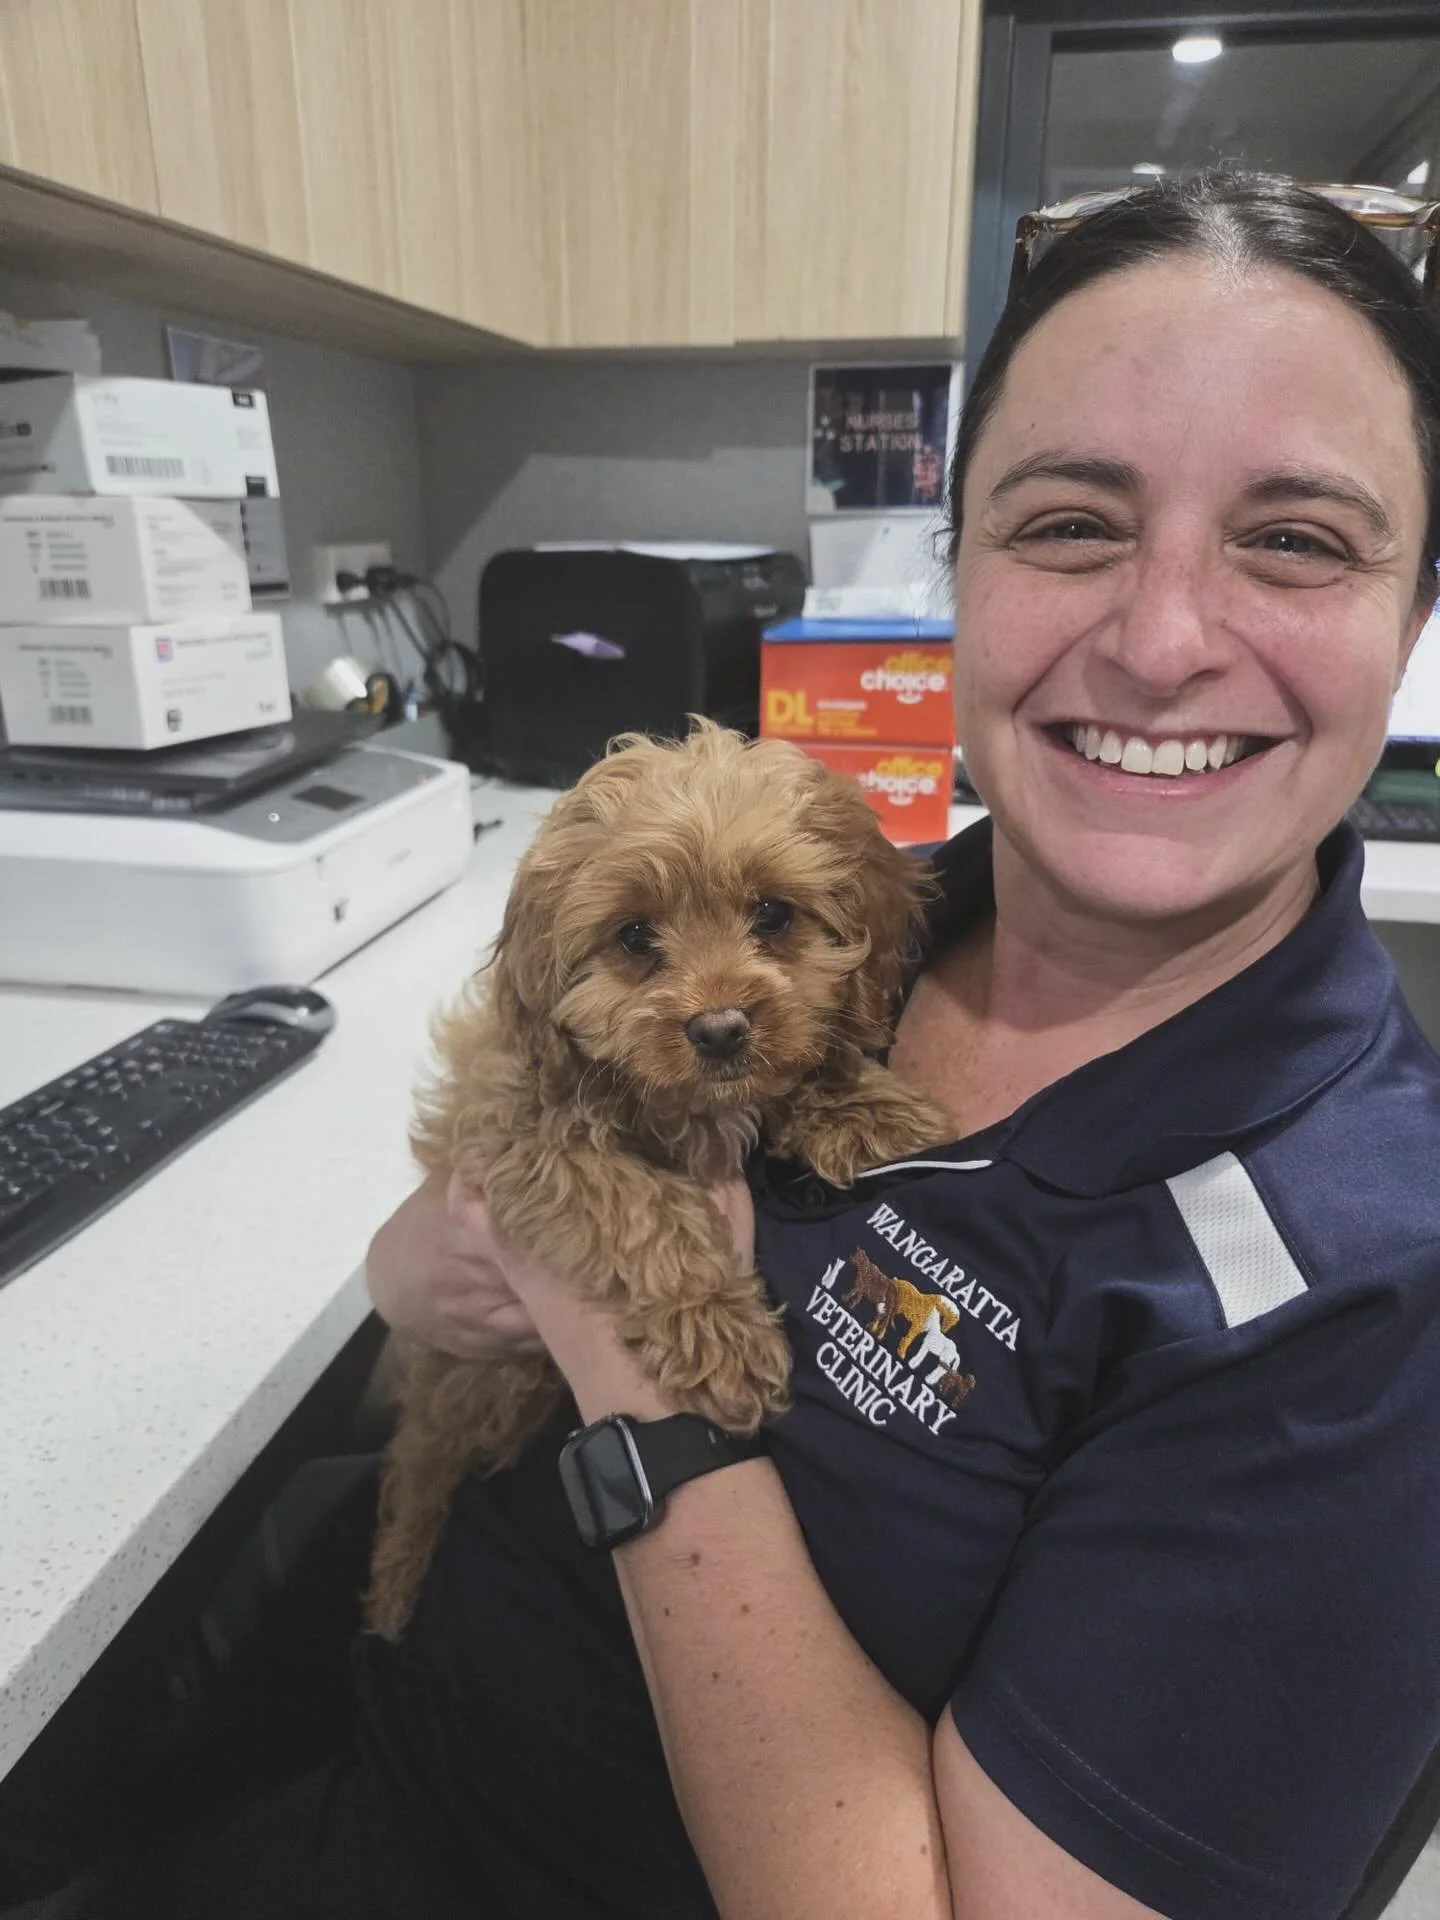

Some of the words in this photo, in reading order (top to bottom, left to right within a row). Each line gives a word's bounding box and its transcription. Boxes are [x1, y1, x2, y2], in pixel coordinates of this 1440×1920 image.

[840, 432, 922, 453] STATION
[766, 689, 814, 726] DL
[860, 667, 947, 692] choice
[867, 1202, 1021, 1351] WANGARATTA
[805, 1285, 957, 1435] VETERINARY
[816, 1342, 897, 1426] CLINIC
